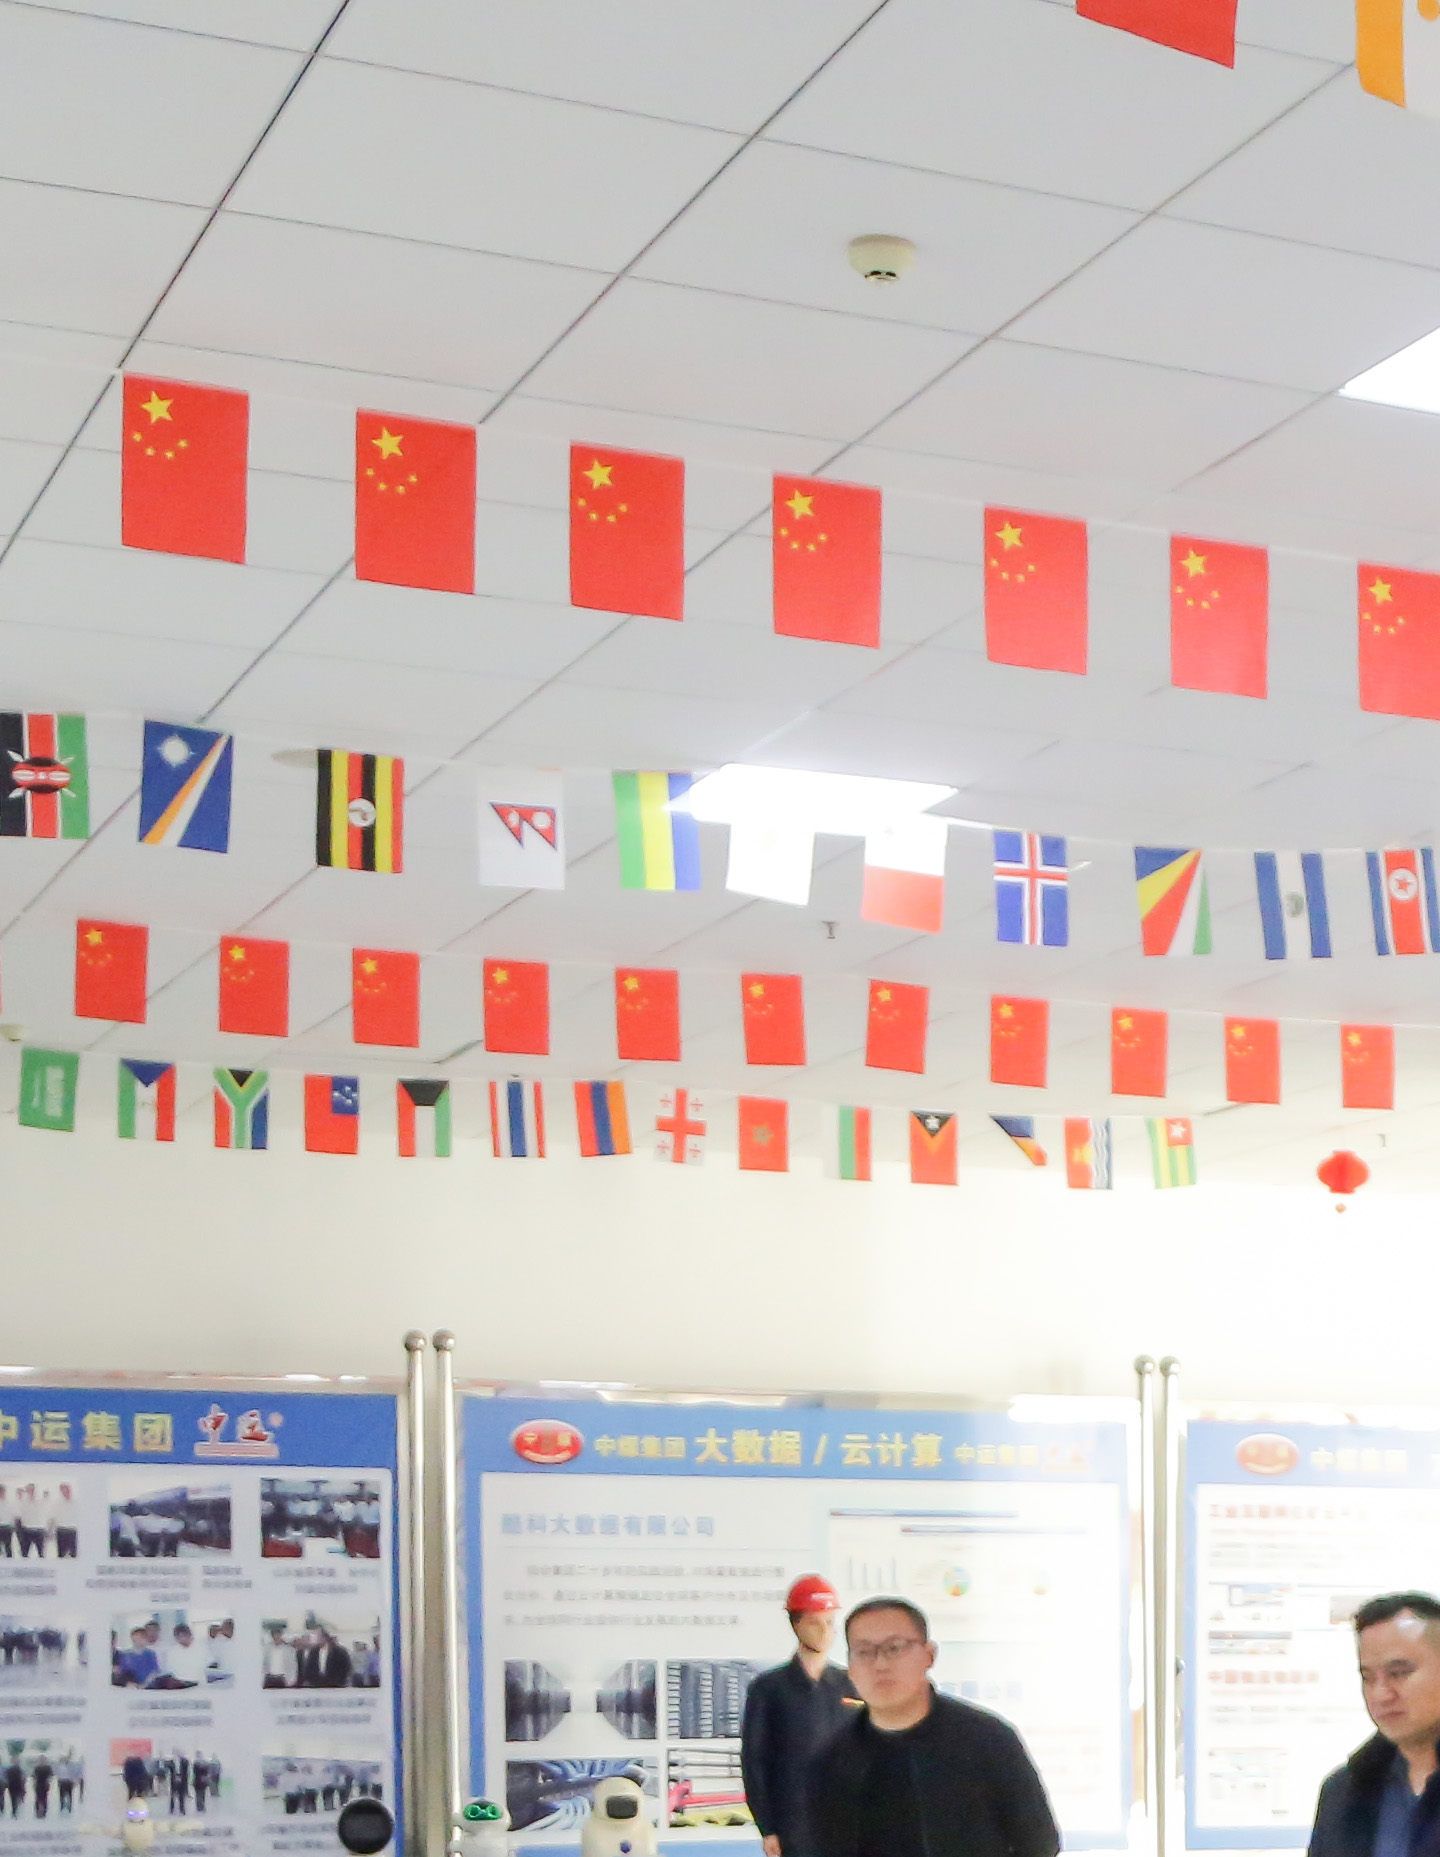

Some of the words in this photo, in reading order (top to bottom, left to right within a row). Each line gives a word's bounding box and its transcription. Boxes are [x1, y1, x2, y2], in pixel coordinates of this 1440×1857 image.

[695, 1428, 802, 1465] 大数据
[841, 1432, 943, 1468] 云计算
